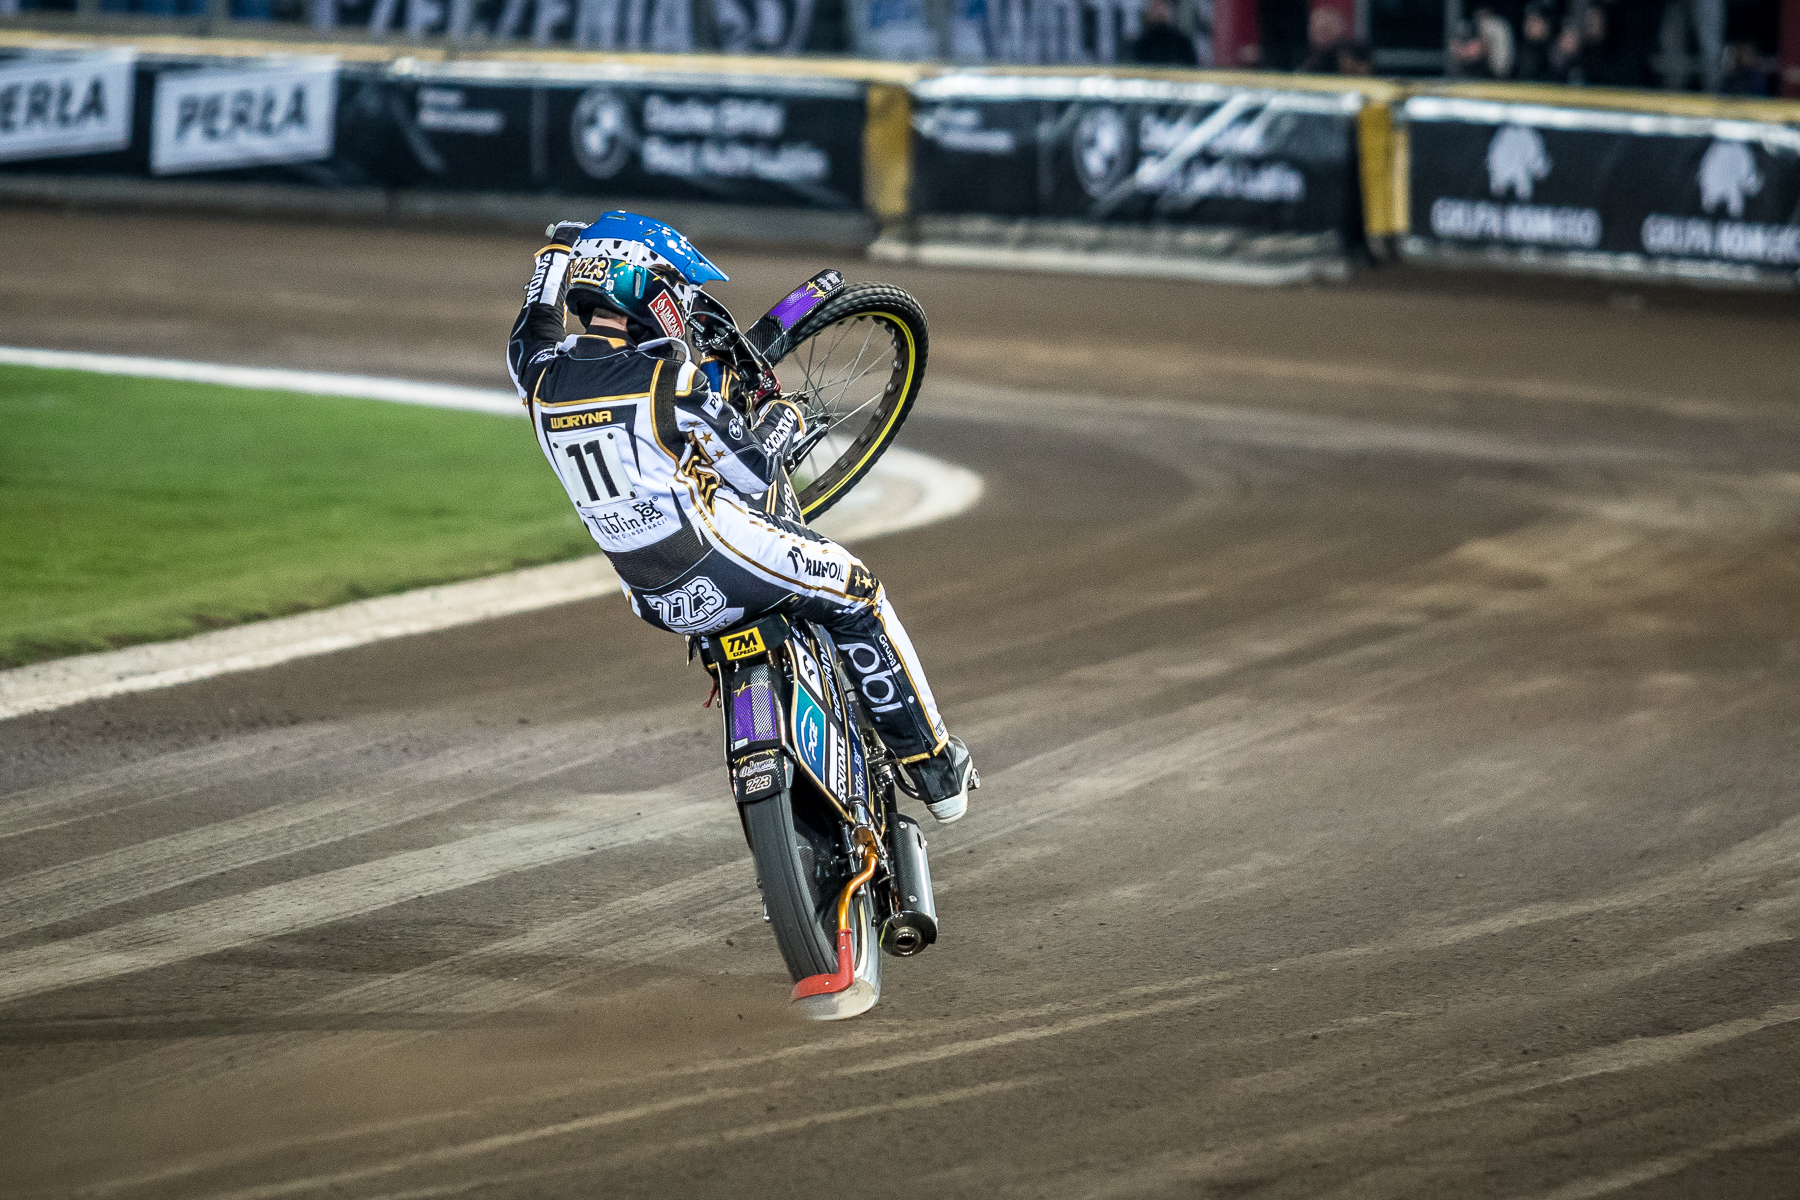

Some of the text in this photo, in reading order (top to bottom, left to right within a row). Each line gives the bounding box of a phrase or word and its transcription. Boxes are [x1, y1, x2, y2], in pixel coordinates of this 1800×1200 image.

[0, 75, 107, 135] ERŁA
[550, 410, 612, 430] WORYNA
[565, 439, 621, 502] 11
[643, 575, 728, 626] 223
[727, 632, 758, 654] TM
[732, 646, 758, 657] EXPRESS
[878, 633, 897, 667] Grupa
[745, 774, 772, 795] 223
[837, 735, 847, 804] SOUDAL
